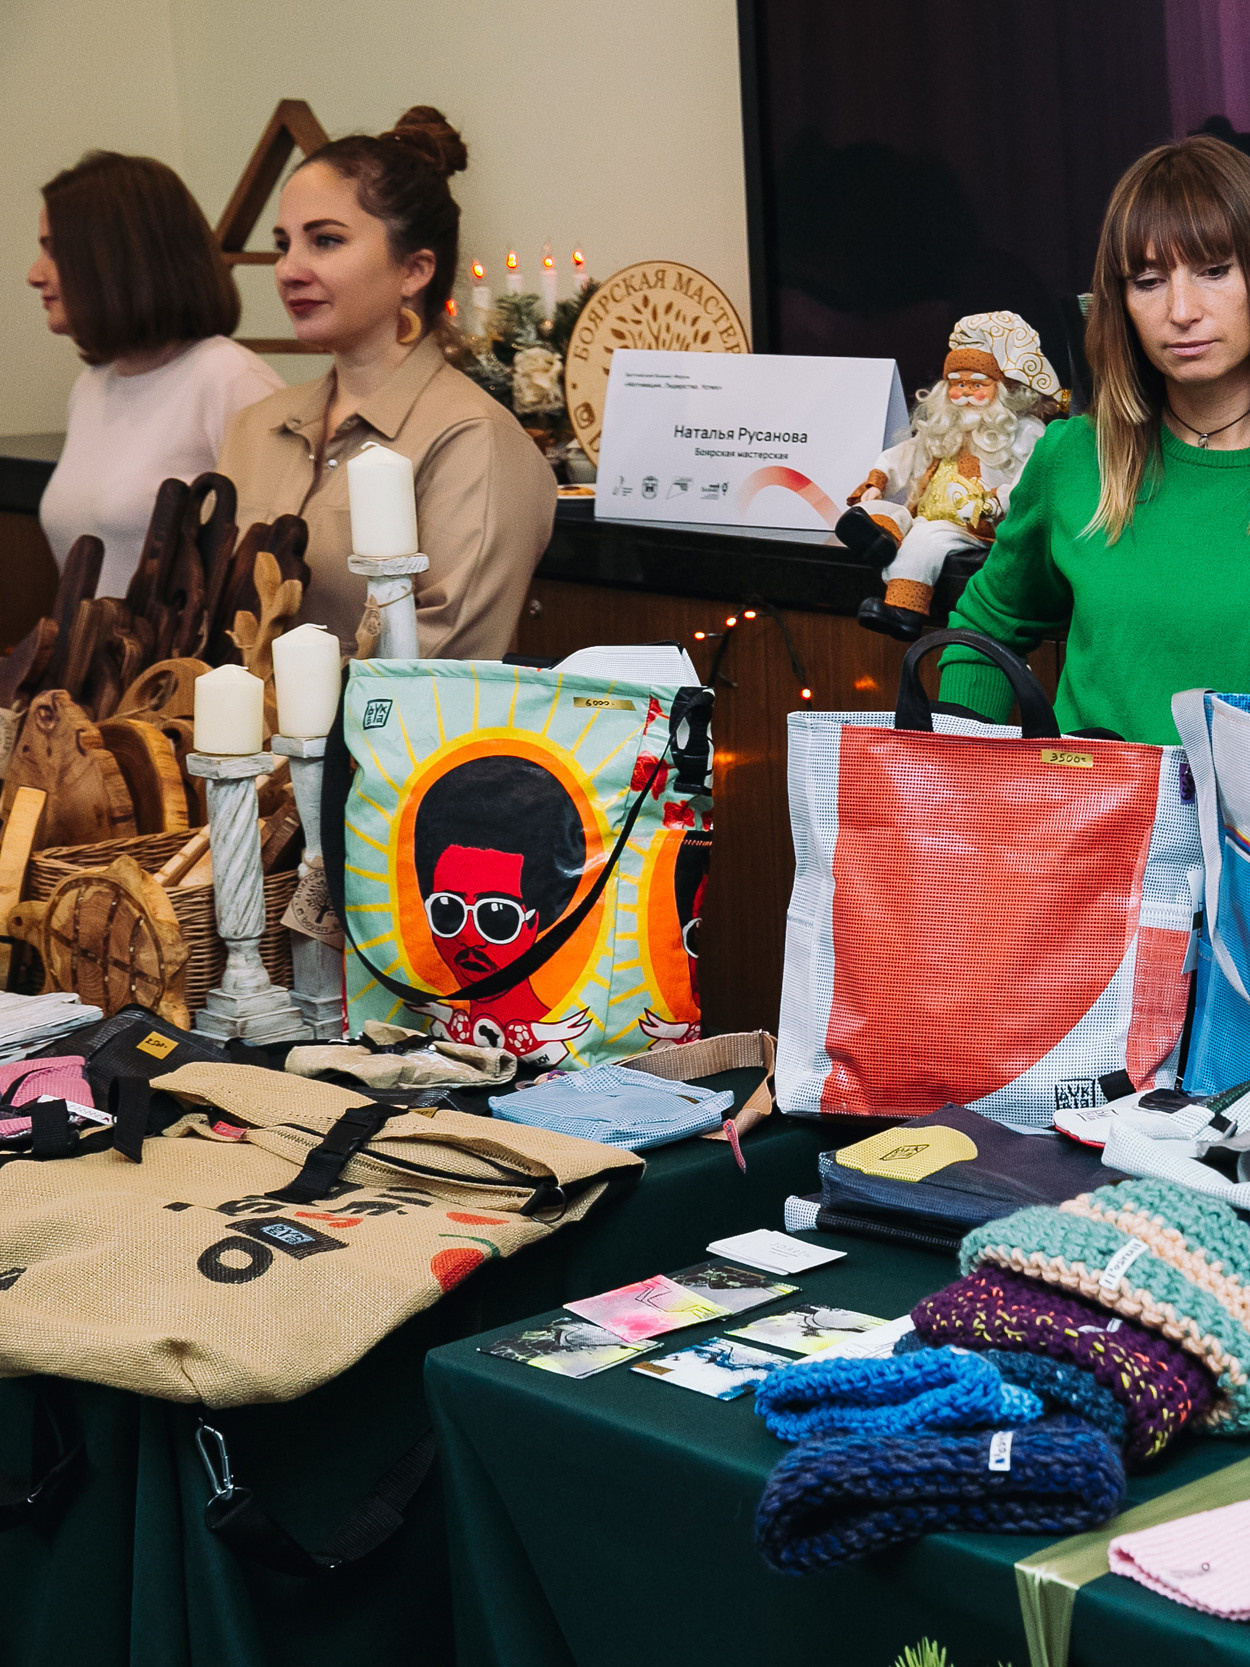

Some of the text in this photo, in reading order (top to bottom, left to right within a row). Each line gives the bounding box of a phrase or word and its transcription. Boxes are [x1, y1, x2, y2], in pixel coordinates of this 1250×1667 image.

[573, 269, 666, 361] БОЯРСКАЯ
[674, 425, 808, 445] Наталья Русанова
